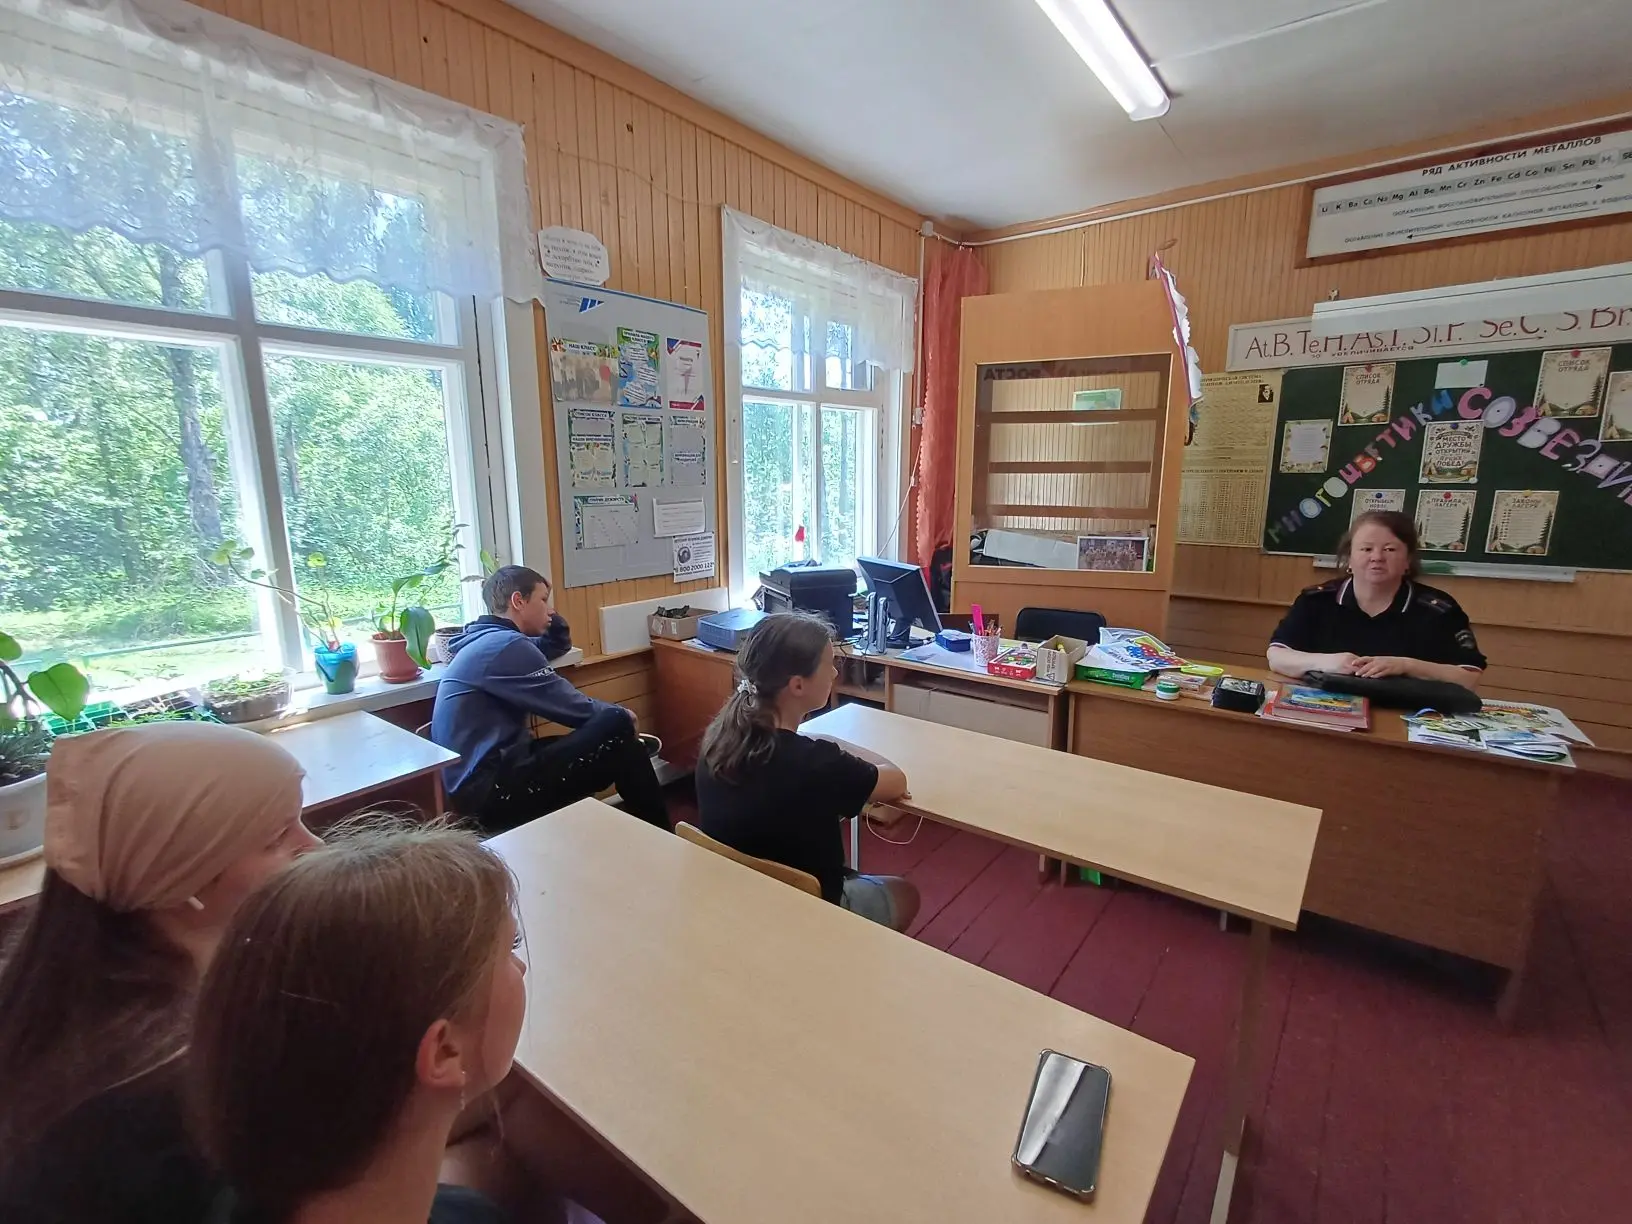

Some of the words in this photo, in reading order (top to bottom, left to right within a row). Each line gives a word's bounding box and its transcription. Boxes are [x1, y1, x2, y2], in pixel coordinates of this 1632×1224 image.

[1421, 166, 1443, 177] РЯД
[1447, 150, 1527, 172] АКТИВНОСТИ
[1532, 136, 1602, 156] МЕТАЛЛОВ
[1457, 181, 1467, 189] Cr
[1474, 179, 1486, 187] Zn
[1507, 172, 1521, 180] Cd
[1525, 169, 1539, 177] Co
[1544, 166, 1557, 174] Ni
[1562, 163, 1576, 171] Sn
[1582, 158, 1596, 167] Pb
[1558, 359, 1591, 367] СПИСОК
[1457, 386, 1632, 507] СОЗВЕЗДИ
[690, 563, 703, 571] 2000
